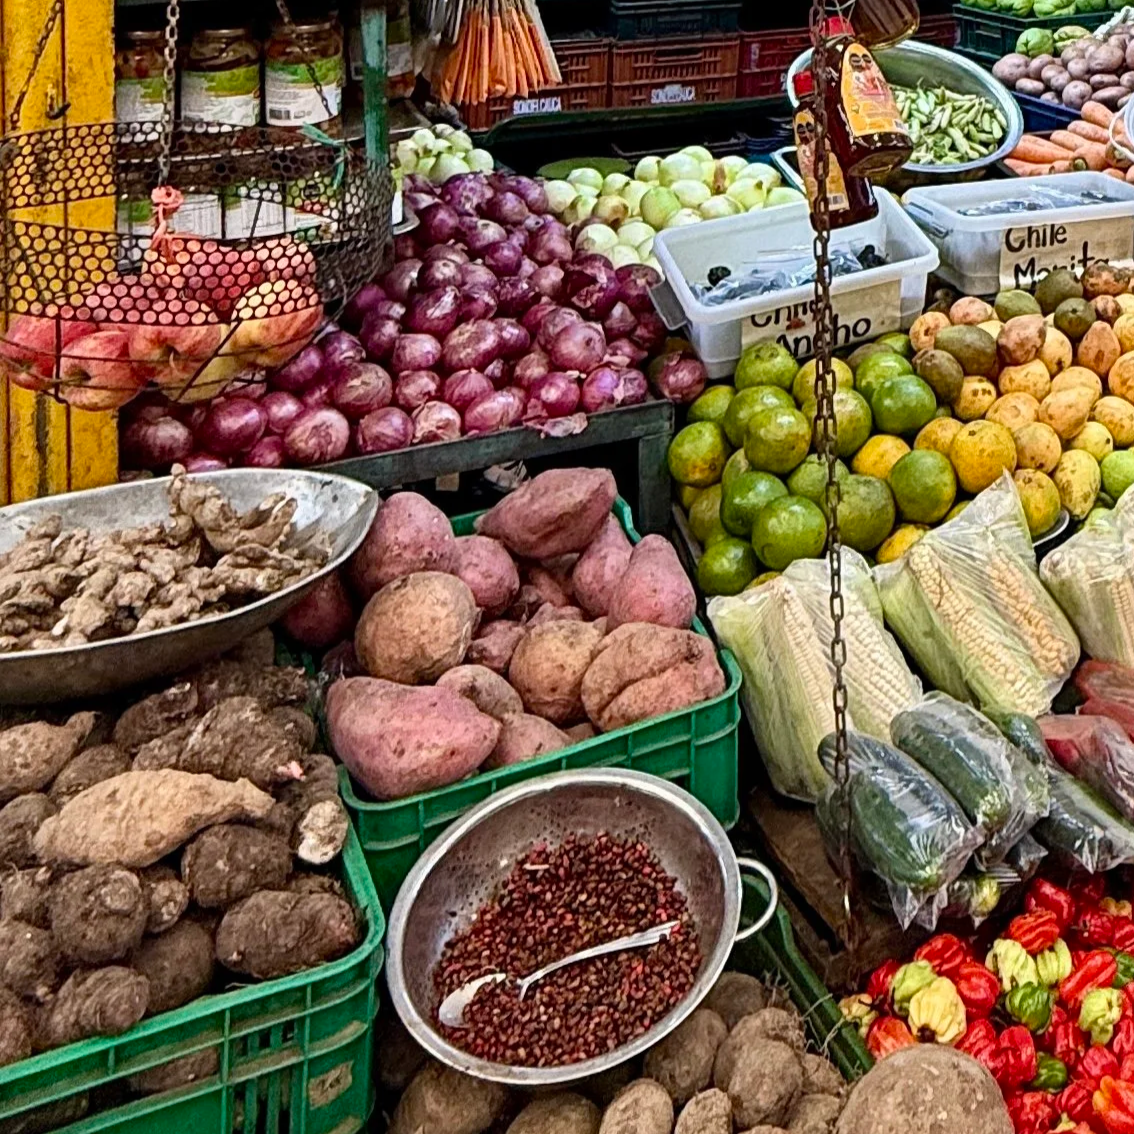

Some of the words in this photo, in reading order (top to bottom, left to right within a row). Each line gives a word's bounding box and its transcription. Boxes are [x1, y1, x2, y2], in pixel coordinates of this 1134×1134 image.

[1005, 223, 1068, 253] Chile
[1013, 240, 1110, 293] Mit
[776, 312, 872, 357] Anho
